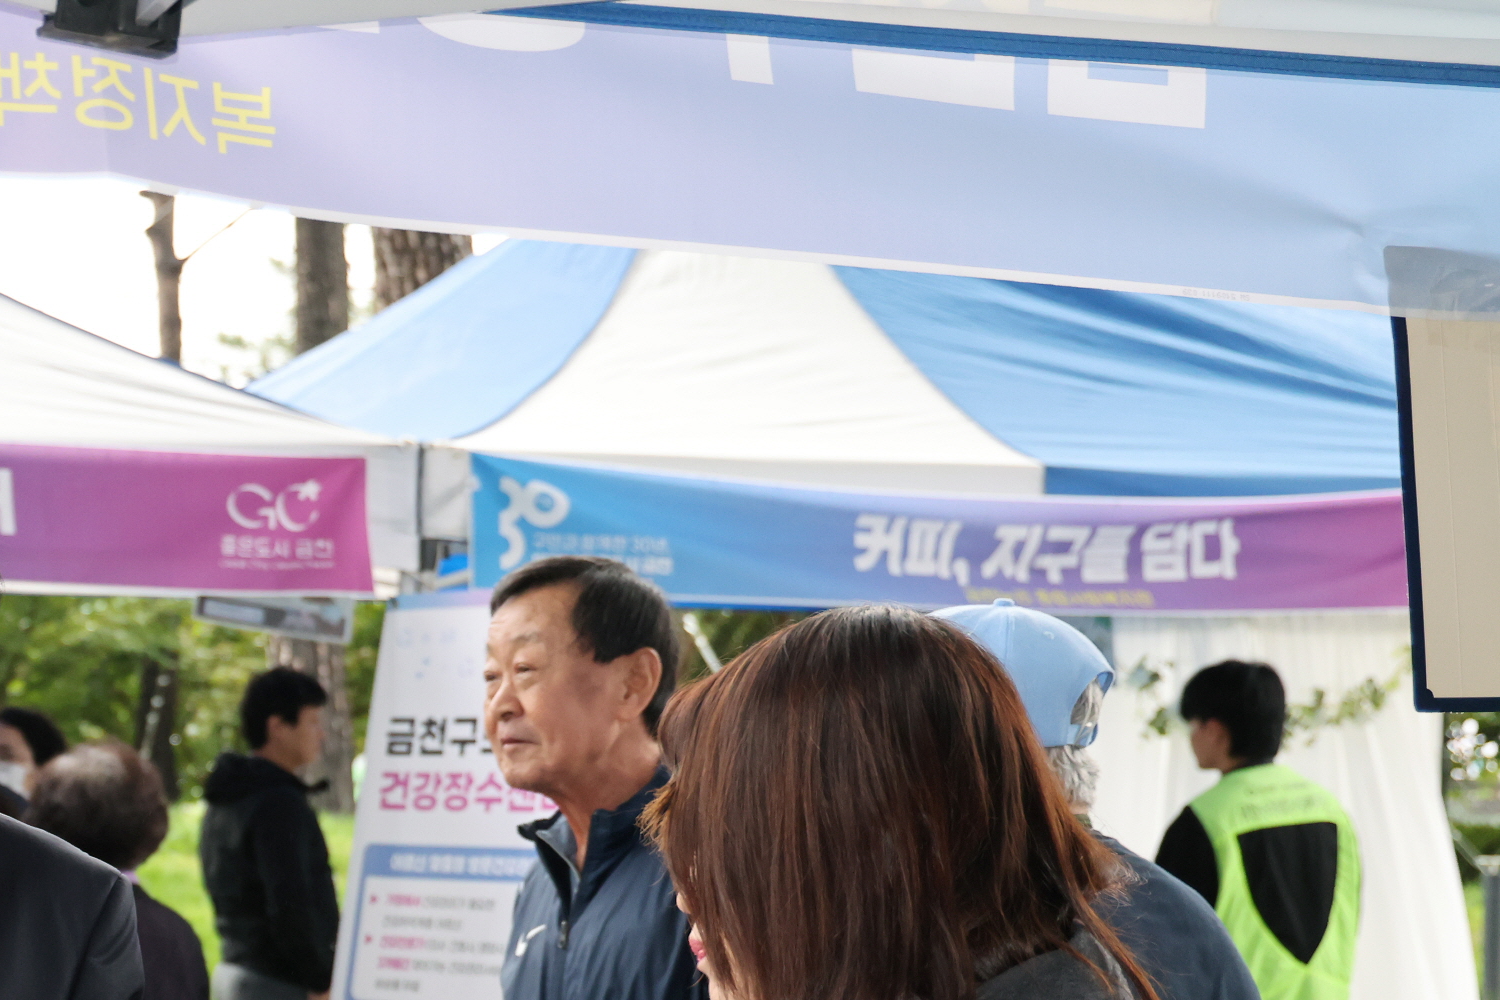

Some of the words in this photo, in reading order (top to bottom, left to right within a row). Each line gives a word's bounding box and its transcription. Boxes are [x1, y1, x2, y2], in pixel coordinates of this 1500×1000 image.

[853, 512, 970, 587] 커피,
[980, 524, 1139, 584] 지구를
[1141, 517, 1241, 582] 담다
[387, 717, 493, 757] 금천구
